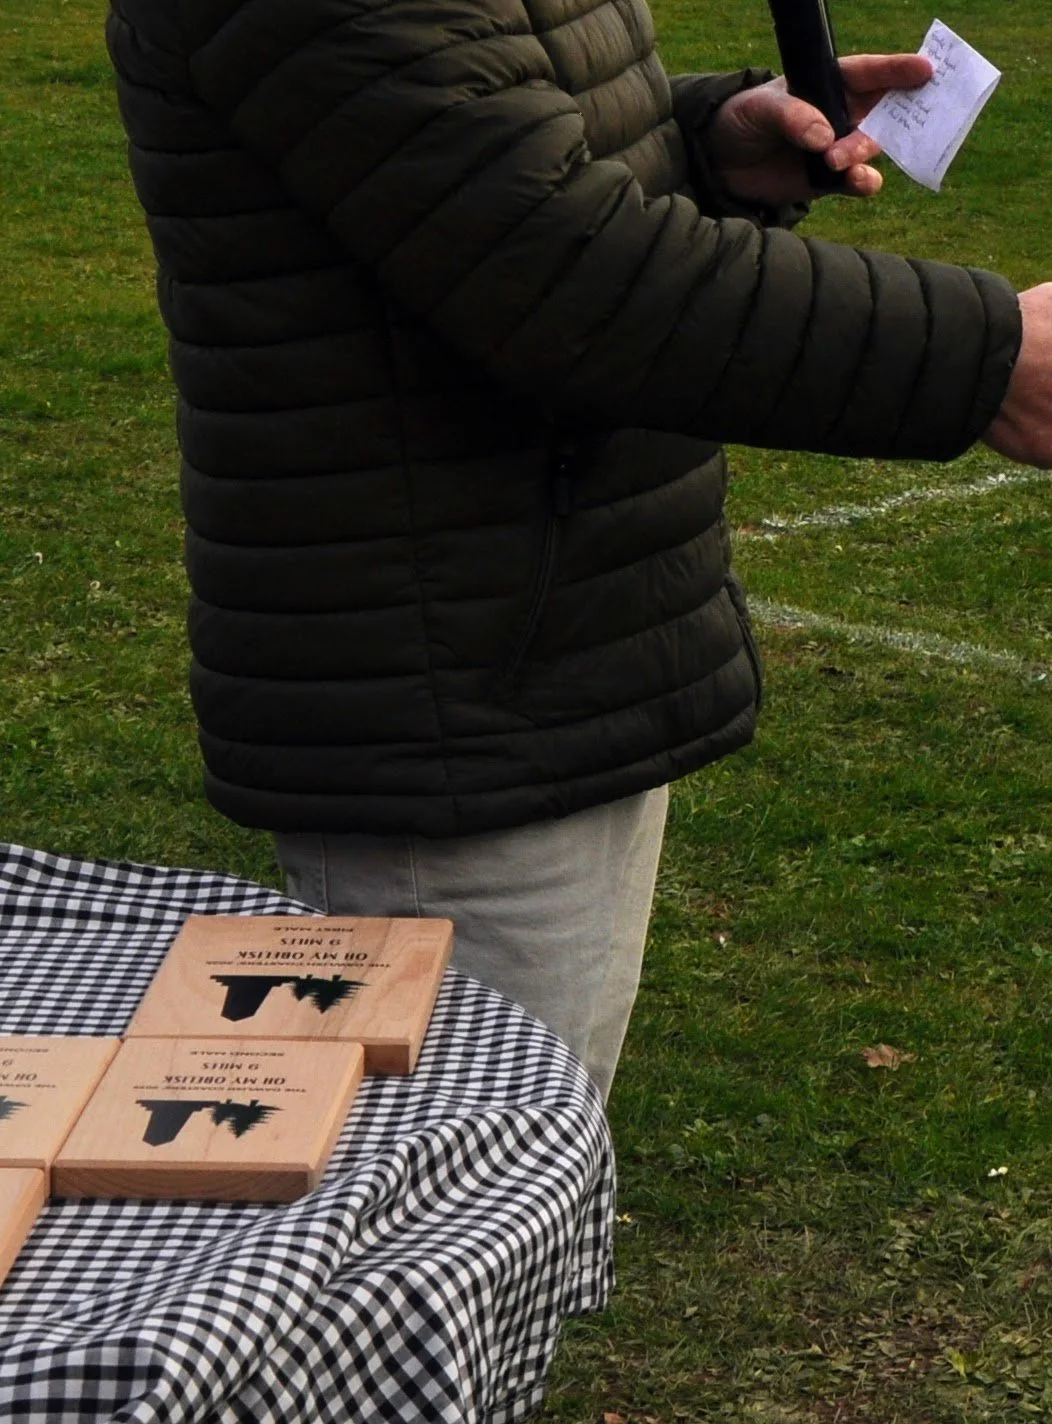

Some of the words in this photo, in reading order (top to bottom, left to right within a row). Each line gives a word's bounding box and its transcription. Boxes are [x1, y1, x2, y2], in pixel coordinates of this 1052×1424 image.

[280, 937, 323, 946] MILES
[237, 950, 305, 960] OBELISK
[310, 951, 338, 961] MY
[344, 952, 369, 961] OH
[164, 1075, 226, 1084] OBELISK
[232, 1076, 258, 1085] MY
[263, 1076, 287, 1085] OH
